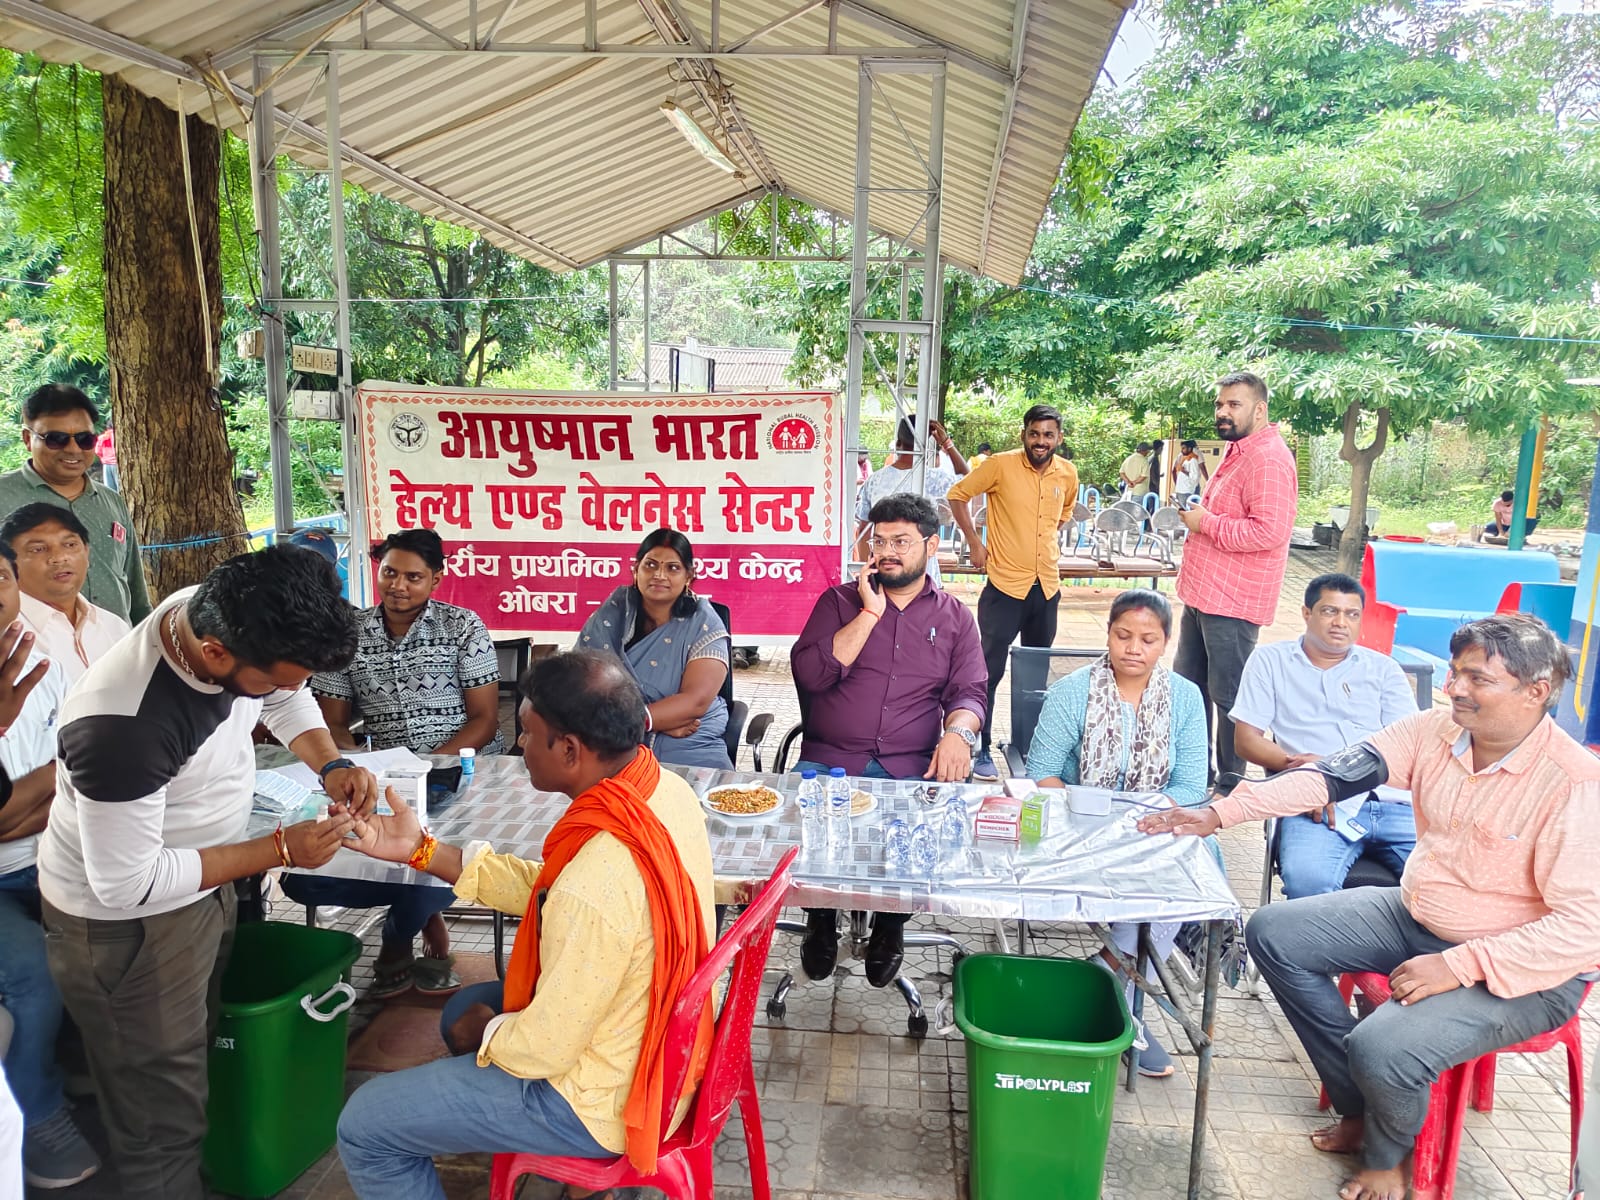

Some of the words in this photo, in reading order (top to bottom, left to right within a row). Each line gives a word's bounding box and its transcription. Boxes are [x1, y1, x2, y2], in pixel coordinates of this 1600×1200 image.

[795, 413, 814, 424] HEALTH
[438, 411, 634, 478] आयुष्मान
[653, 413, 762, 461] भारत
[389, 469, 474, 529] हेल्थ
[485, 484, 566, 530] एण्ड
[577, 471, 706, 532] वेलनेस
[718, 471, 814, 533] सेन्टर
[509, 548, 622, 580] प्राथमिक
[738, 552, 804, 584] केन्द्र
[498, 585, 577, 615] ओबरा
